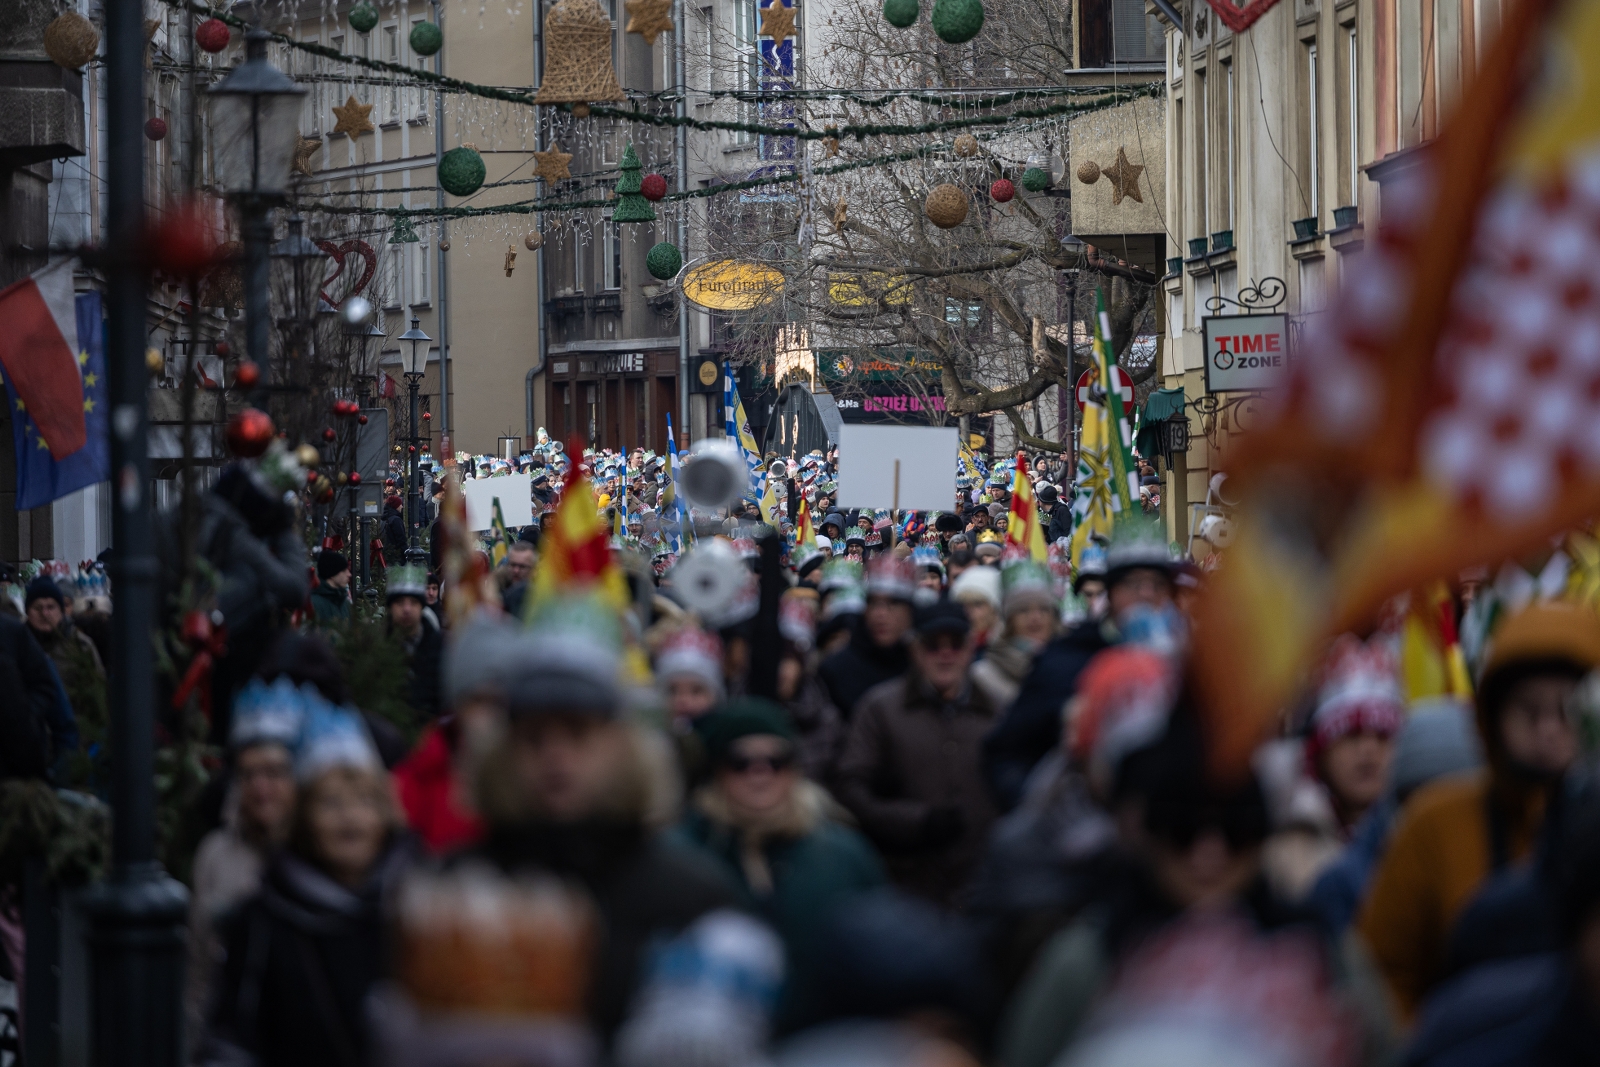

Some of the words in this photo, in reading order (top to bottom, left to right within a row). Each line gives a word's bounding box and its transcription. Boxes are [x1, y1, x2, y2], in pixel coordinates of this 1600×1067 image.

[1215, 334, 1281, 354] TIME
[1238, 356, 1281, 368] ZONE
[865, 394, 908, 411] ODZIEŻ
[1172, 426, 1184, 446] 19
